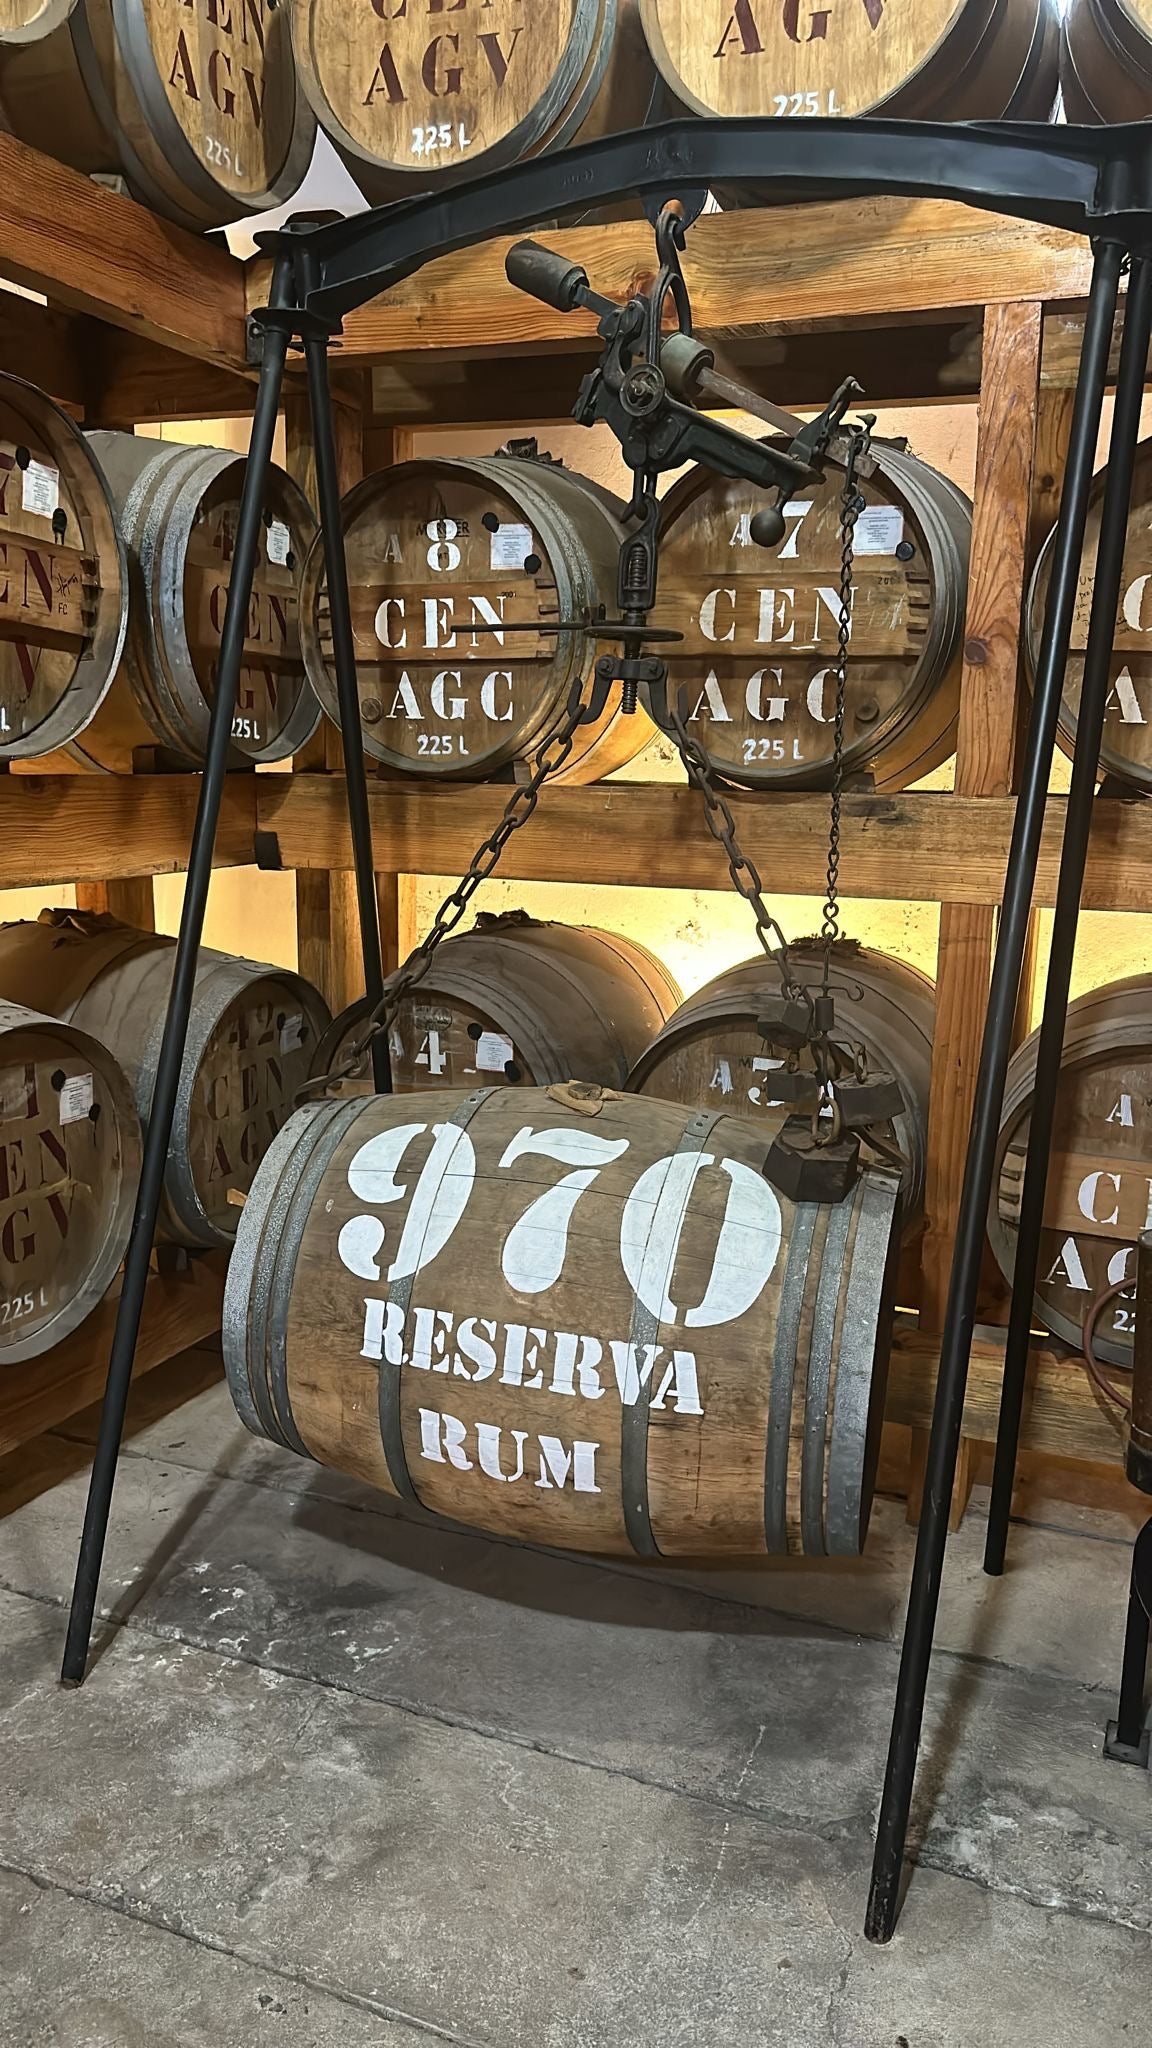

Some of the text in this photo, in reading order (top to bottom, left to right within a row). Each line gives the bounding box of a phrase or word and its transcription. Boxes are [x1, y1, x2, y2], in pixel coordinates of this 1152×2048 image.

[169, 27, 266, 130] AGV
[361, 27, 525, 106] AGV
[772, 88, 841, 117] 225 L
[205, 135, 231, 172] 225
[411, 124, 452, 158] 225
[383, 533, 404, 564] A
[426, 518, 461, 572] 8
[776, 499, 816, 559] 7
[374, 595, 507, 649] CEN
[698, 586, 859, 643] CEN
[386, 671, 514, 722] AGC
[417, 735, 470, 755] 225 L
[742, 738, 805, 764] 225 L
[414, 1030, 447, 1075] 4
[709, 1060, 734, 1095] A
[206, 1056, 283, 1121] CEN
[1104, 1094, 1135, 1128] A
[337, 1122, 783, 1328] 970
[0, 1291, 34, 1324] 225
[359, 1297, 705, 1416] RESERVA
[418, 1408, 602, 1494] RUM
